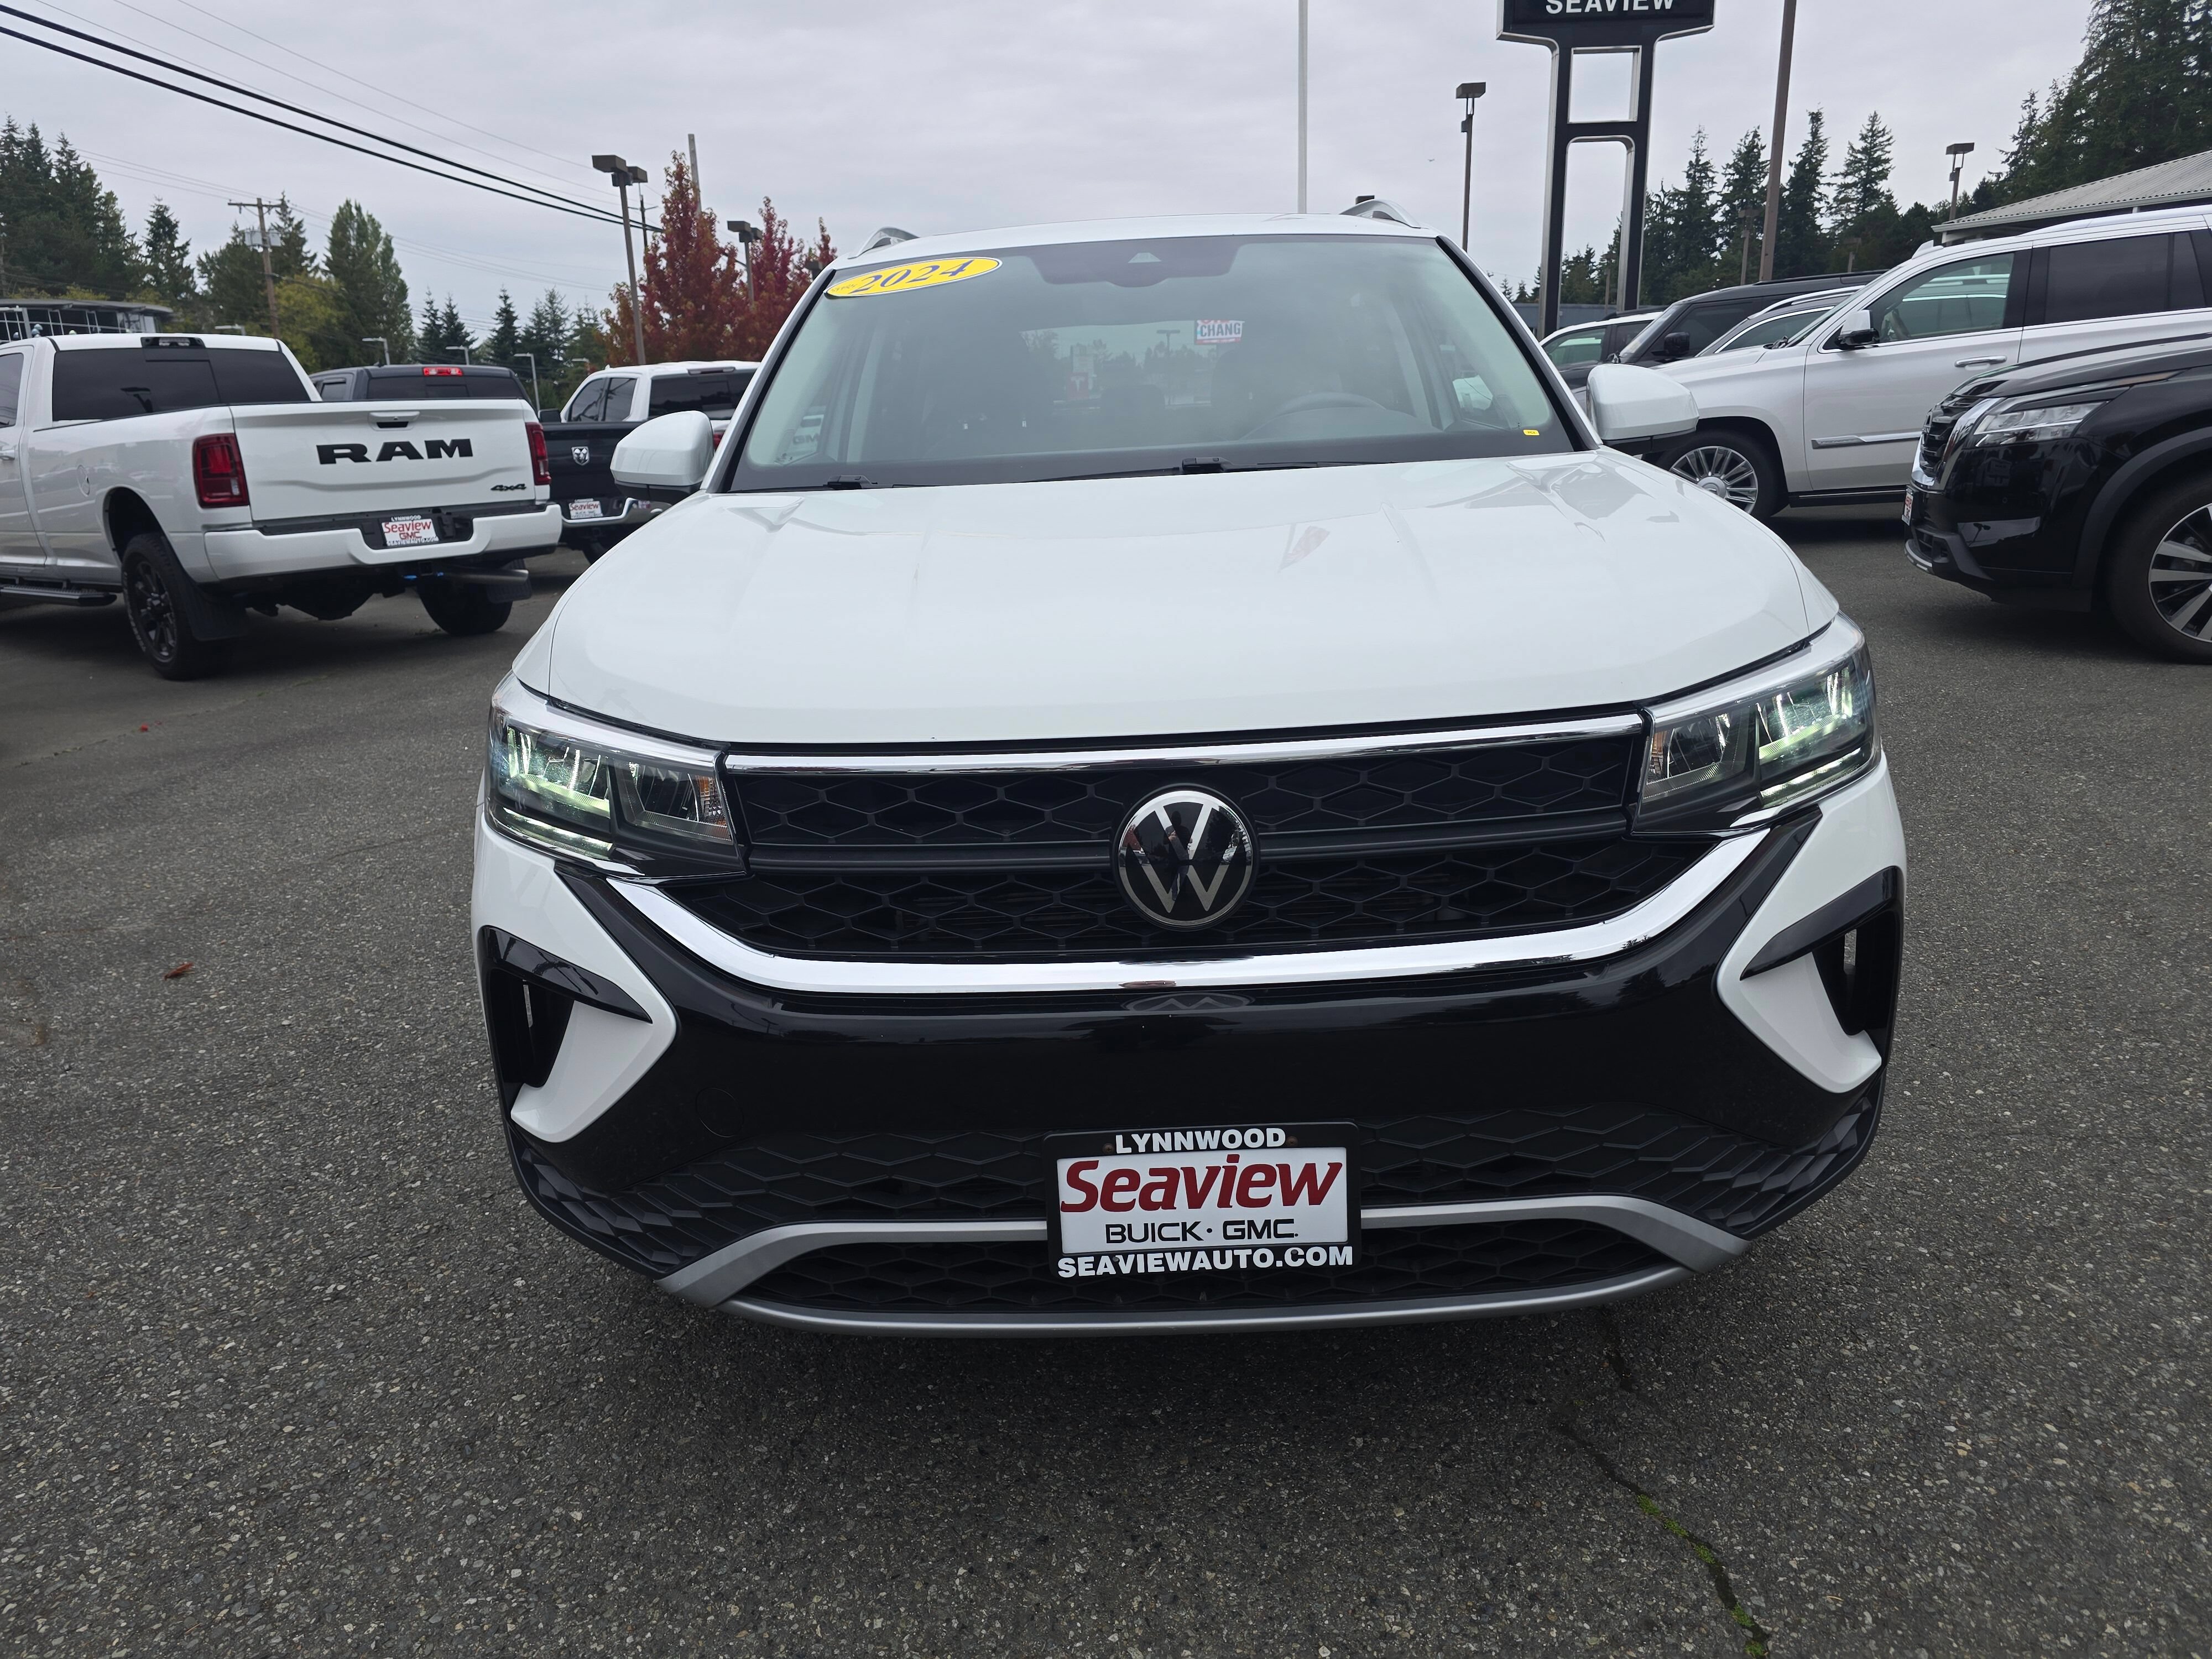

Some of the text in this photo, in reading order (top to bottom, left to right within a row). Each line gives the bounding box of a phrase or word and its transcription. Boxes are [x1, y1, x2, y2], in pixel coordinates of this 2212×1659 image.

[848, 258, 975, 294] 2024
[1201, 322, 1241, 337] CHANG
[316, 439, 473, 465] RAM
[384, 520, 431, 534] Seaview
[1116, 1128, 1286, 1154] LYNNWOOD
[1061, 1154, 1343, 1212] Seaview
[1105, 1221, 1204, 1244] BUICK
[1058, 1246, 1353, 1278] SEAVIEWAUTO.COM
